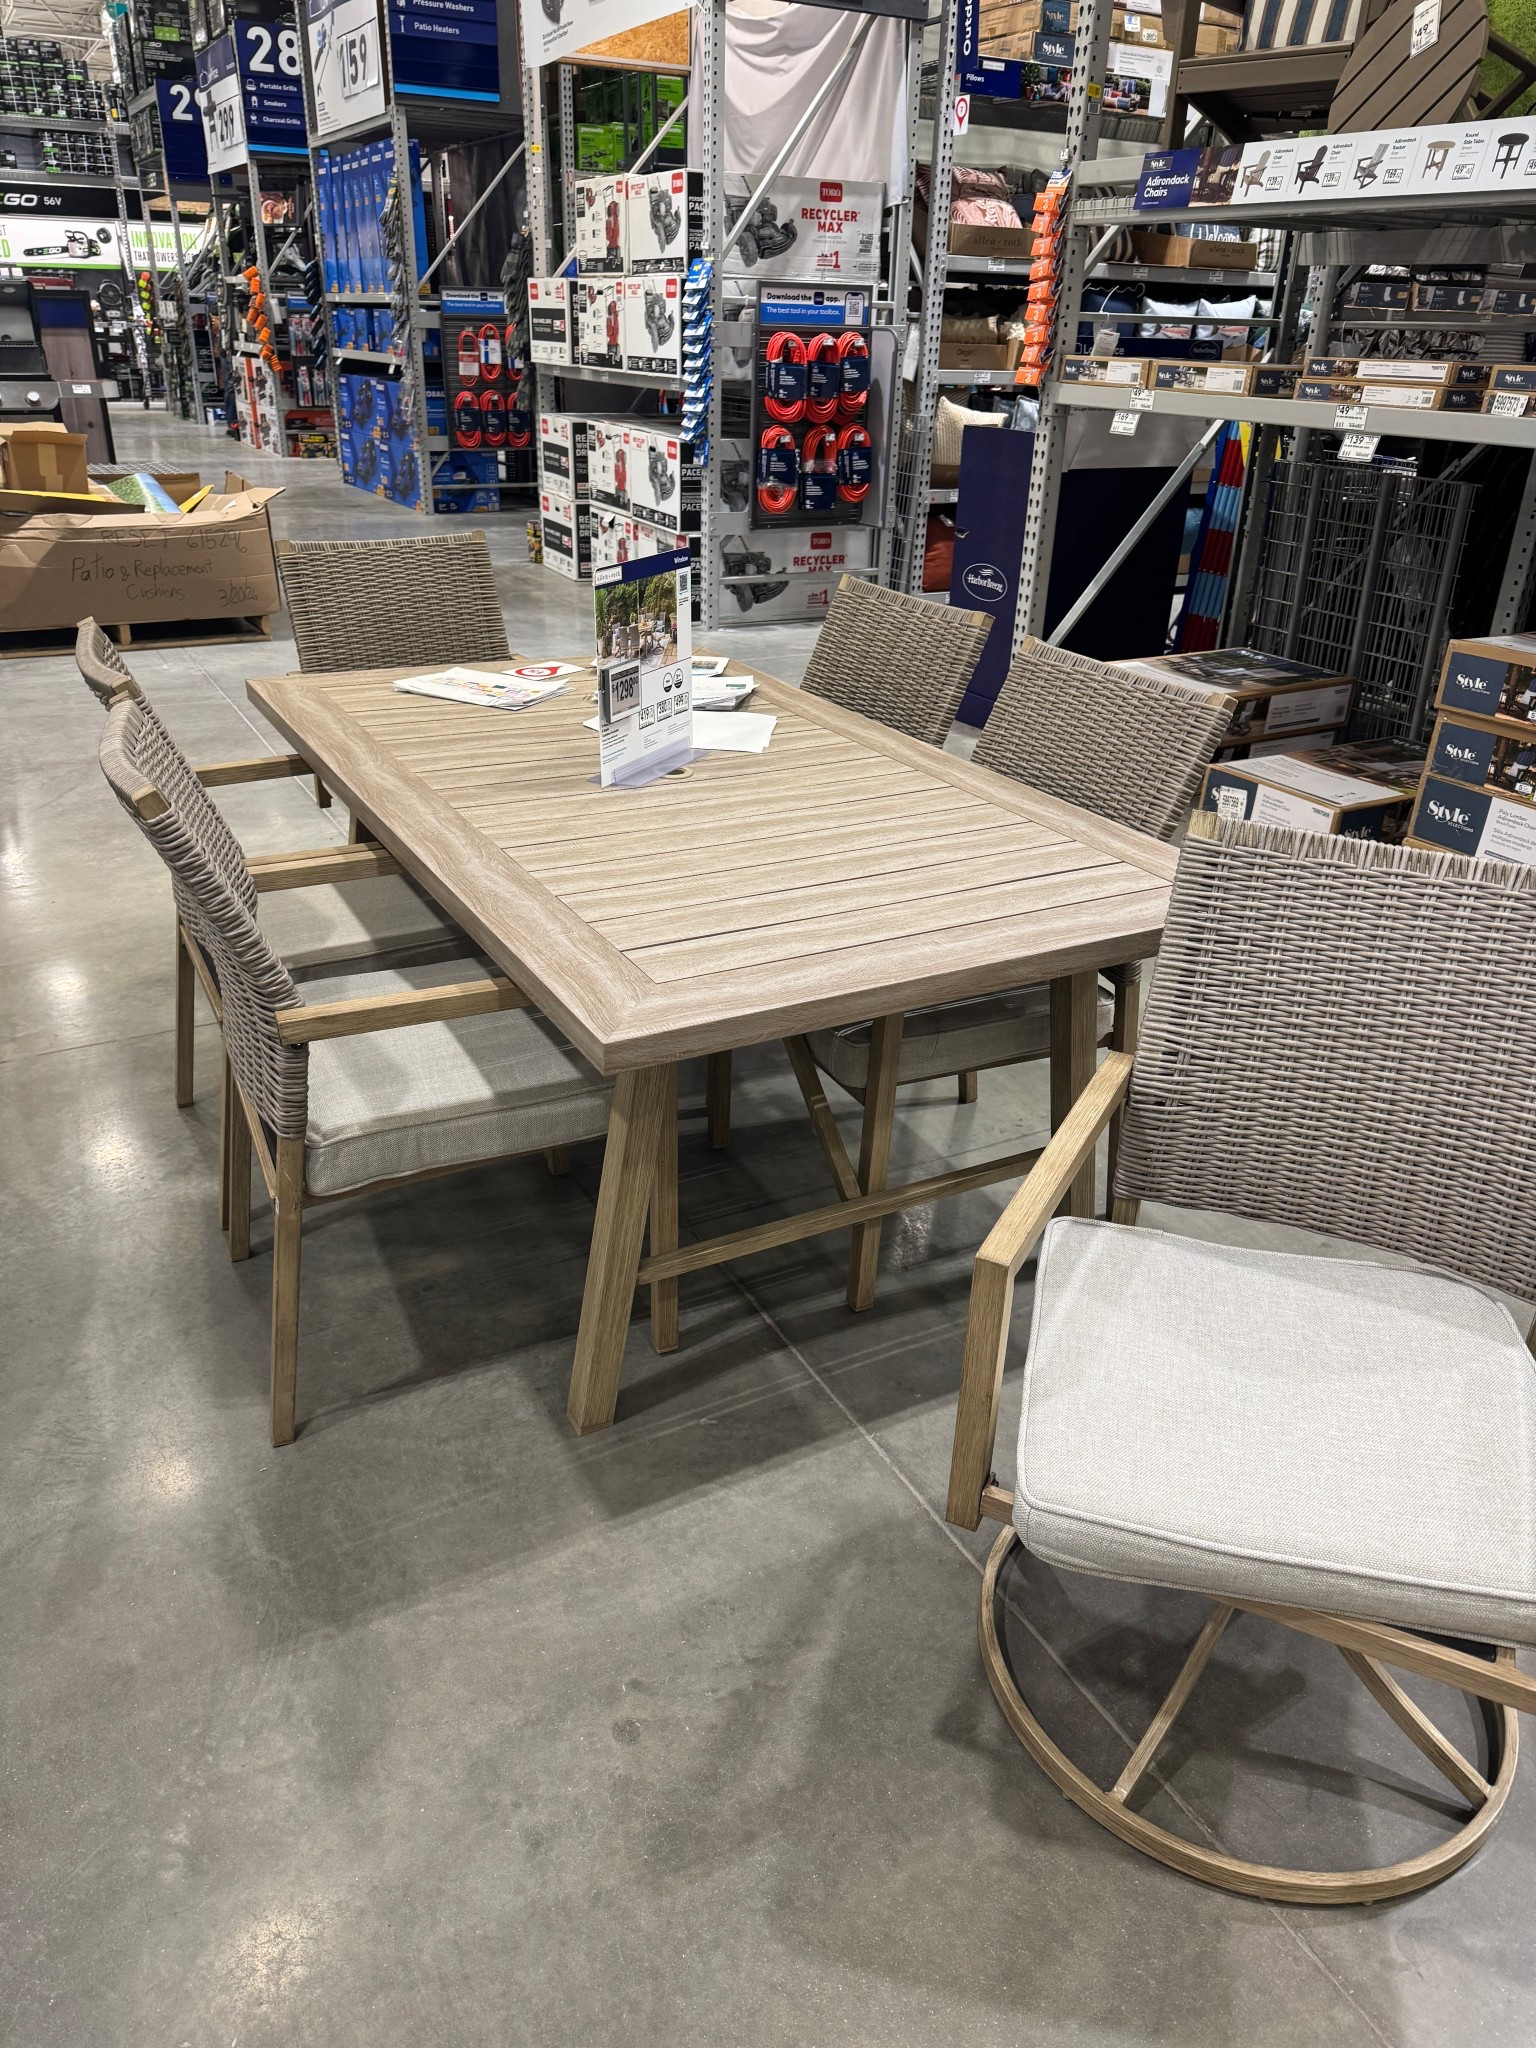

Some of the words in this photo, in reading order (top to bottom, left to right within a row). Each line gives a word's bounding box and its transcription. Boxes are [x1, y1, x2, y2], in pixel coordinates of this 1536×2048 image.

[413, 0, 445, 8] Pressure
[445, 1, 475, 13] Washers
[414, 22, 432, 32] Patio
[433, 24, 460, 35] Heaters
[246, 26, 302, 76] 28
[1042, 41, 1065, 56] Style
[966, 74, 985, 83] Pillows
[283, 83, 298, 92] Grills
[263, 100, 287, 108] Smokers
[263, 116, 286, 125] Charcoal
[286, 118, 301, 126] Grills
[1146, 174, 1190, 187] Adirondack
[821, 188, 841, 197] TORO
[1144, 186, 1168, 198] Chairs
[0, 193, 38, 207] GO
[43, 197, 62, 206] 56V
[801, 207, 858, 222] RECYCLER
[817, 221, 843, 234] MAX
[766, 292, 800, 301] Download
[801, 293, 812, 301] the
[766, 306, 777, 314] The
[1504, 373, 1525, 384] Style
[100, 528, 172, 549] RESET
[811, 537, 831, 546] TORO
[673, 556, 689, 564] Winslow
[793, 554, 846, 567] RECYCLER
[72, 553, 114, 583] Patio
[133, 557, 213, 586] Replacement
[967, 573, 987, 587] Harbor
[986, 578, 1004, 593] Breeze
[125, 583, 186, 601] Cushions
[1456, 673, 1487, 691] Style
[1445, 743, 1477, 761] Style
[1427, 799, 1472, 826] Style
[1498, 808, 1510, 817] Poly
[1509, 812, 1528, 822] Lumber
[1447, 820, 1474, 833] SELECTIONS
[1497, 814, 1523, 827] Adirondack
[1503, 831, 1530, 844] Adirondack
[1511, 840, 1532, 850] maderas
